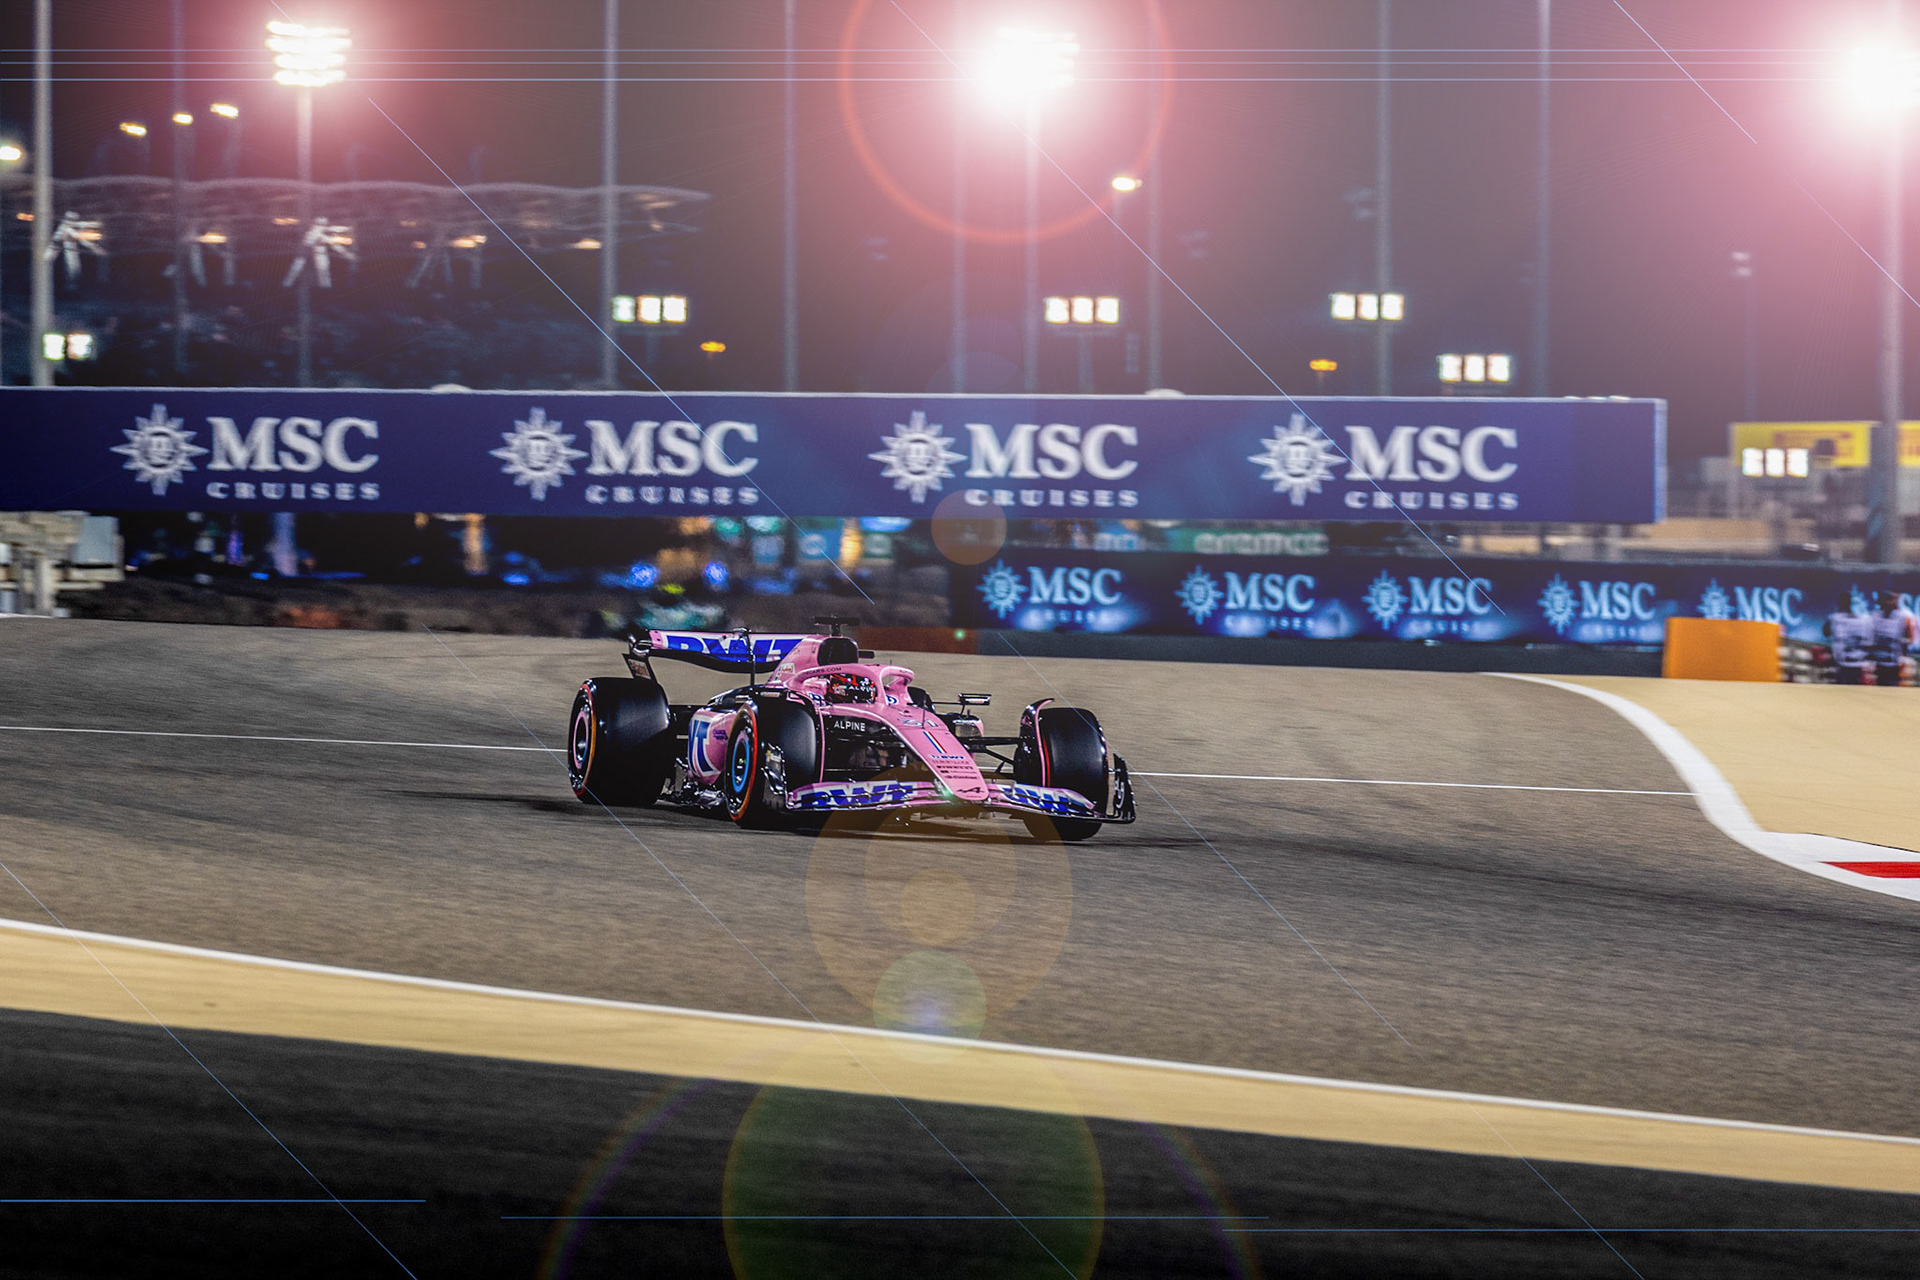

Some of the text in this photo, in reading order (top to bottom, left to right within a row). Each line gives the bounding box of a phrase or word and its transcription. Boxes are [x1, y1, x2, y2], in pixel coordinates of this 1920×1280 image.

[205, 417, 379, 473] MSC
[586, 420, 759, 477] MSC
[964, 423, 1138, 480] MSC
[1345, 425, 1518, 483] MSC
[206, 481, 379, 501] CRUISES
[585, 484, 759, 505] CRUISES
[964, 489, 1139, 508] CRUISES
[1344, 491, 1519, 511] CRUISES
[1027, 566, 1122, 605] MSC
[1224, 572, 1315, 612] MSC
[1408, 576, 1492, 615] MSC
[1578, 580, 1656, 620] MSC
[1734, 586, 1803, 625] MSC
[834, 720, 866, 732] ALPINE
